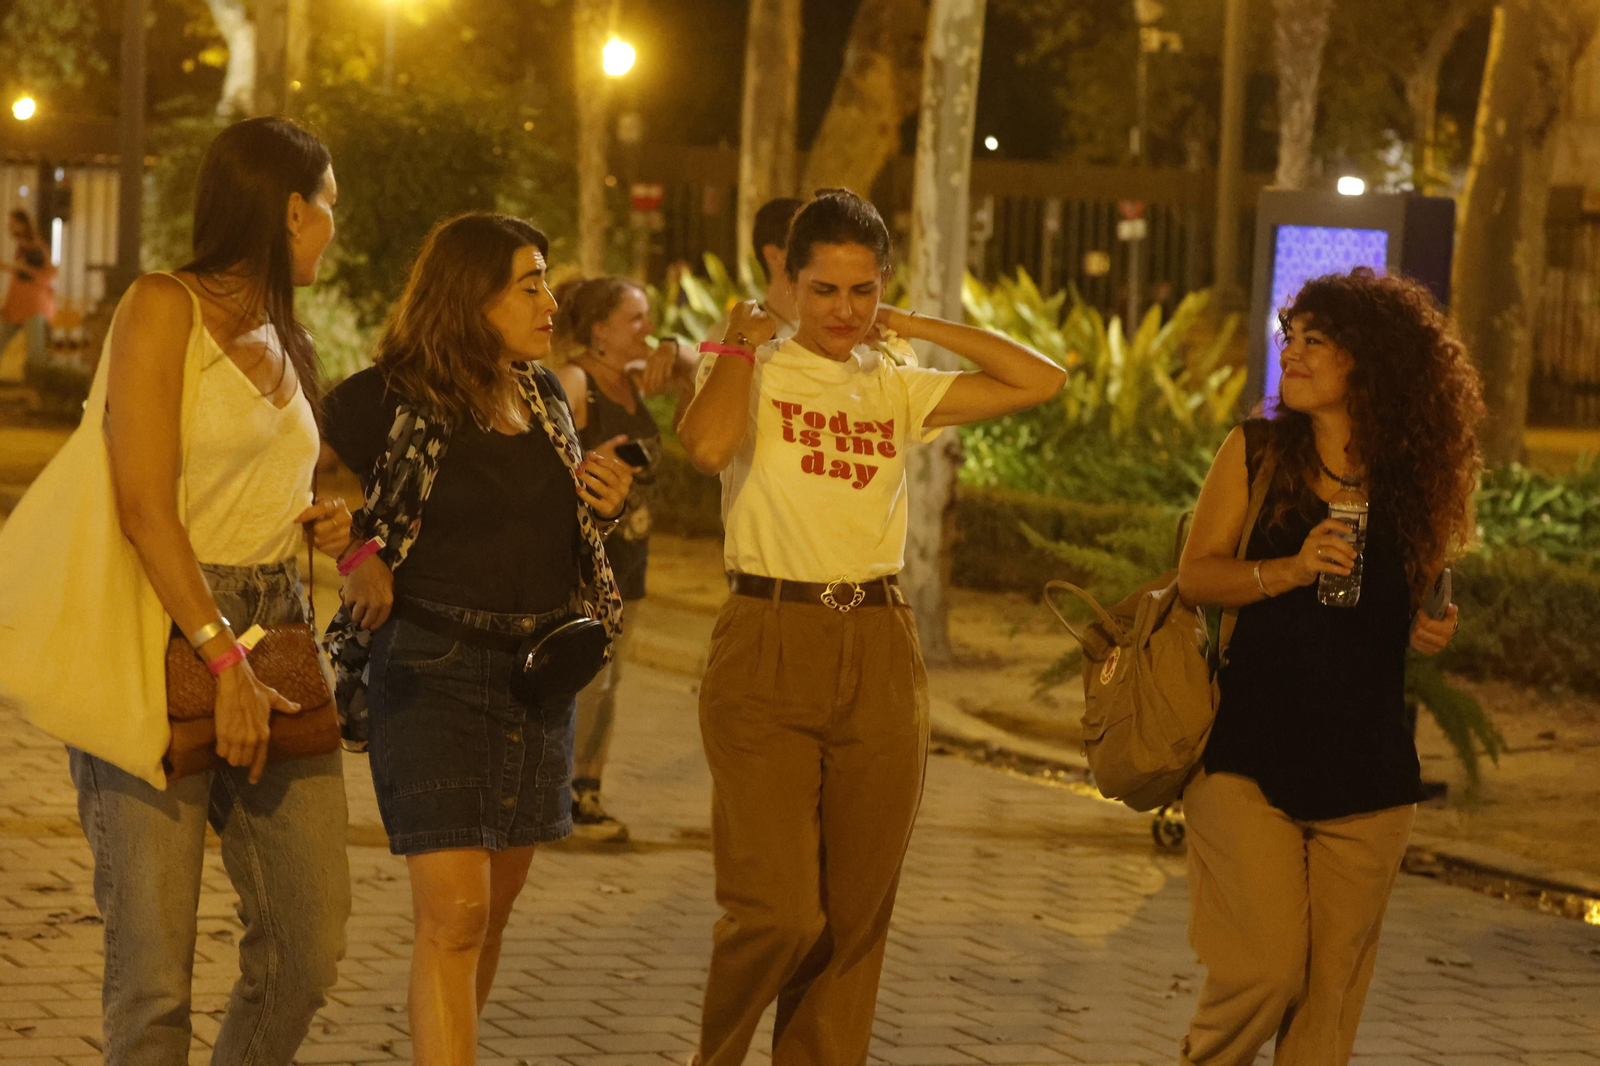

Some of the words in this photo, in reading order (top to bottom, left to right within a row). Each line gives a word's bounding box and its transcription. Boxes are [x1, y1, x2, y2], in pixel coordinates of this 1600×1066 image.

[772, 399, 894, 439] Today
[781, 420, 821, 447] is
[801, 450, 879, 490] day
